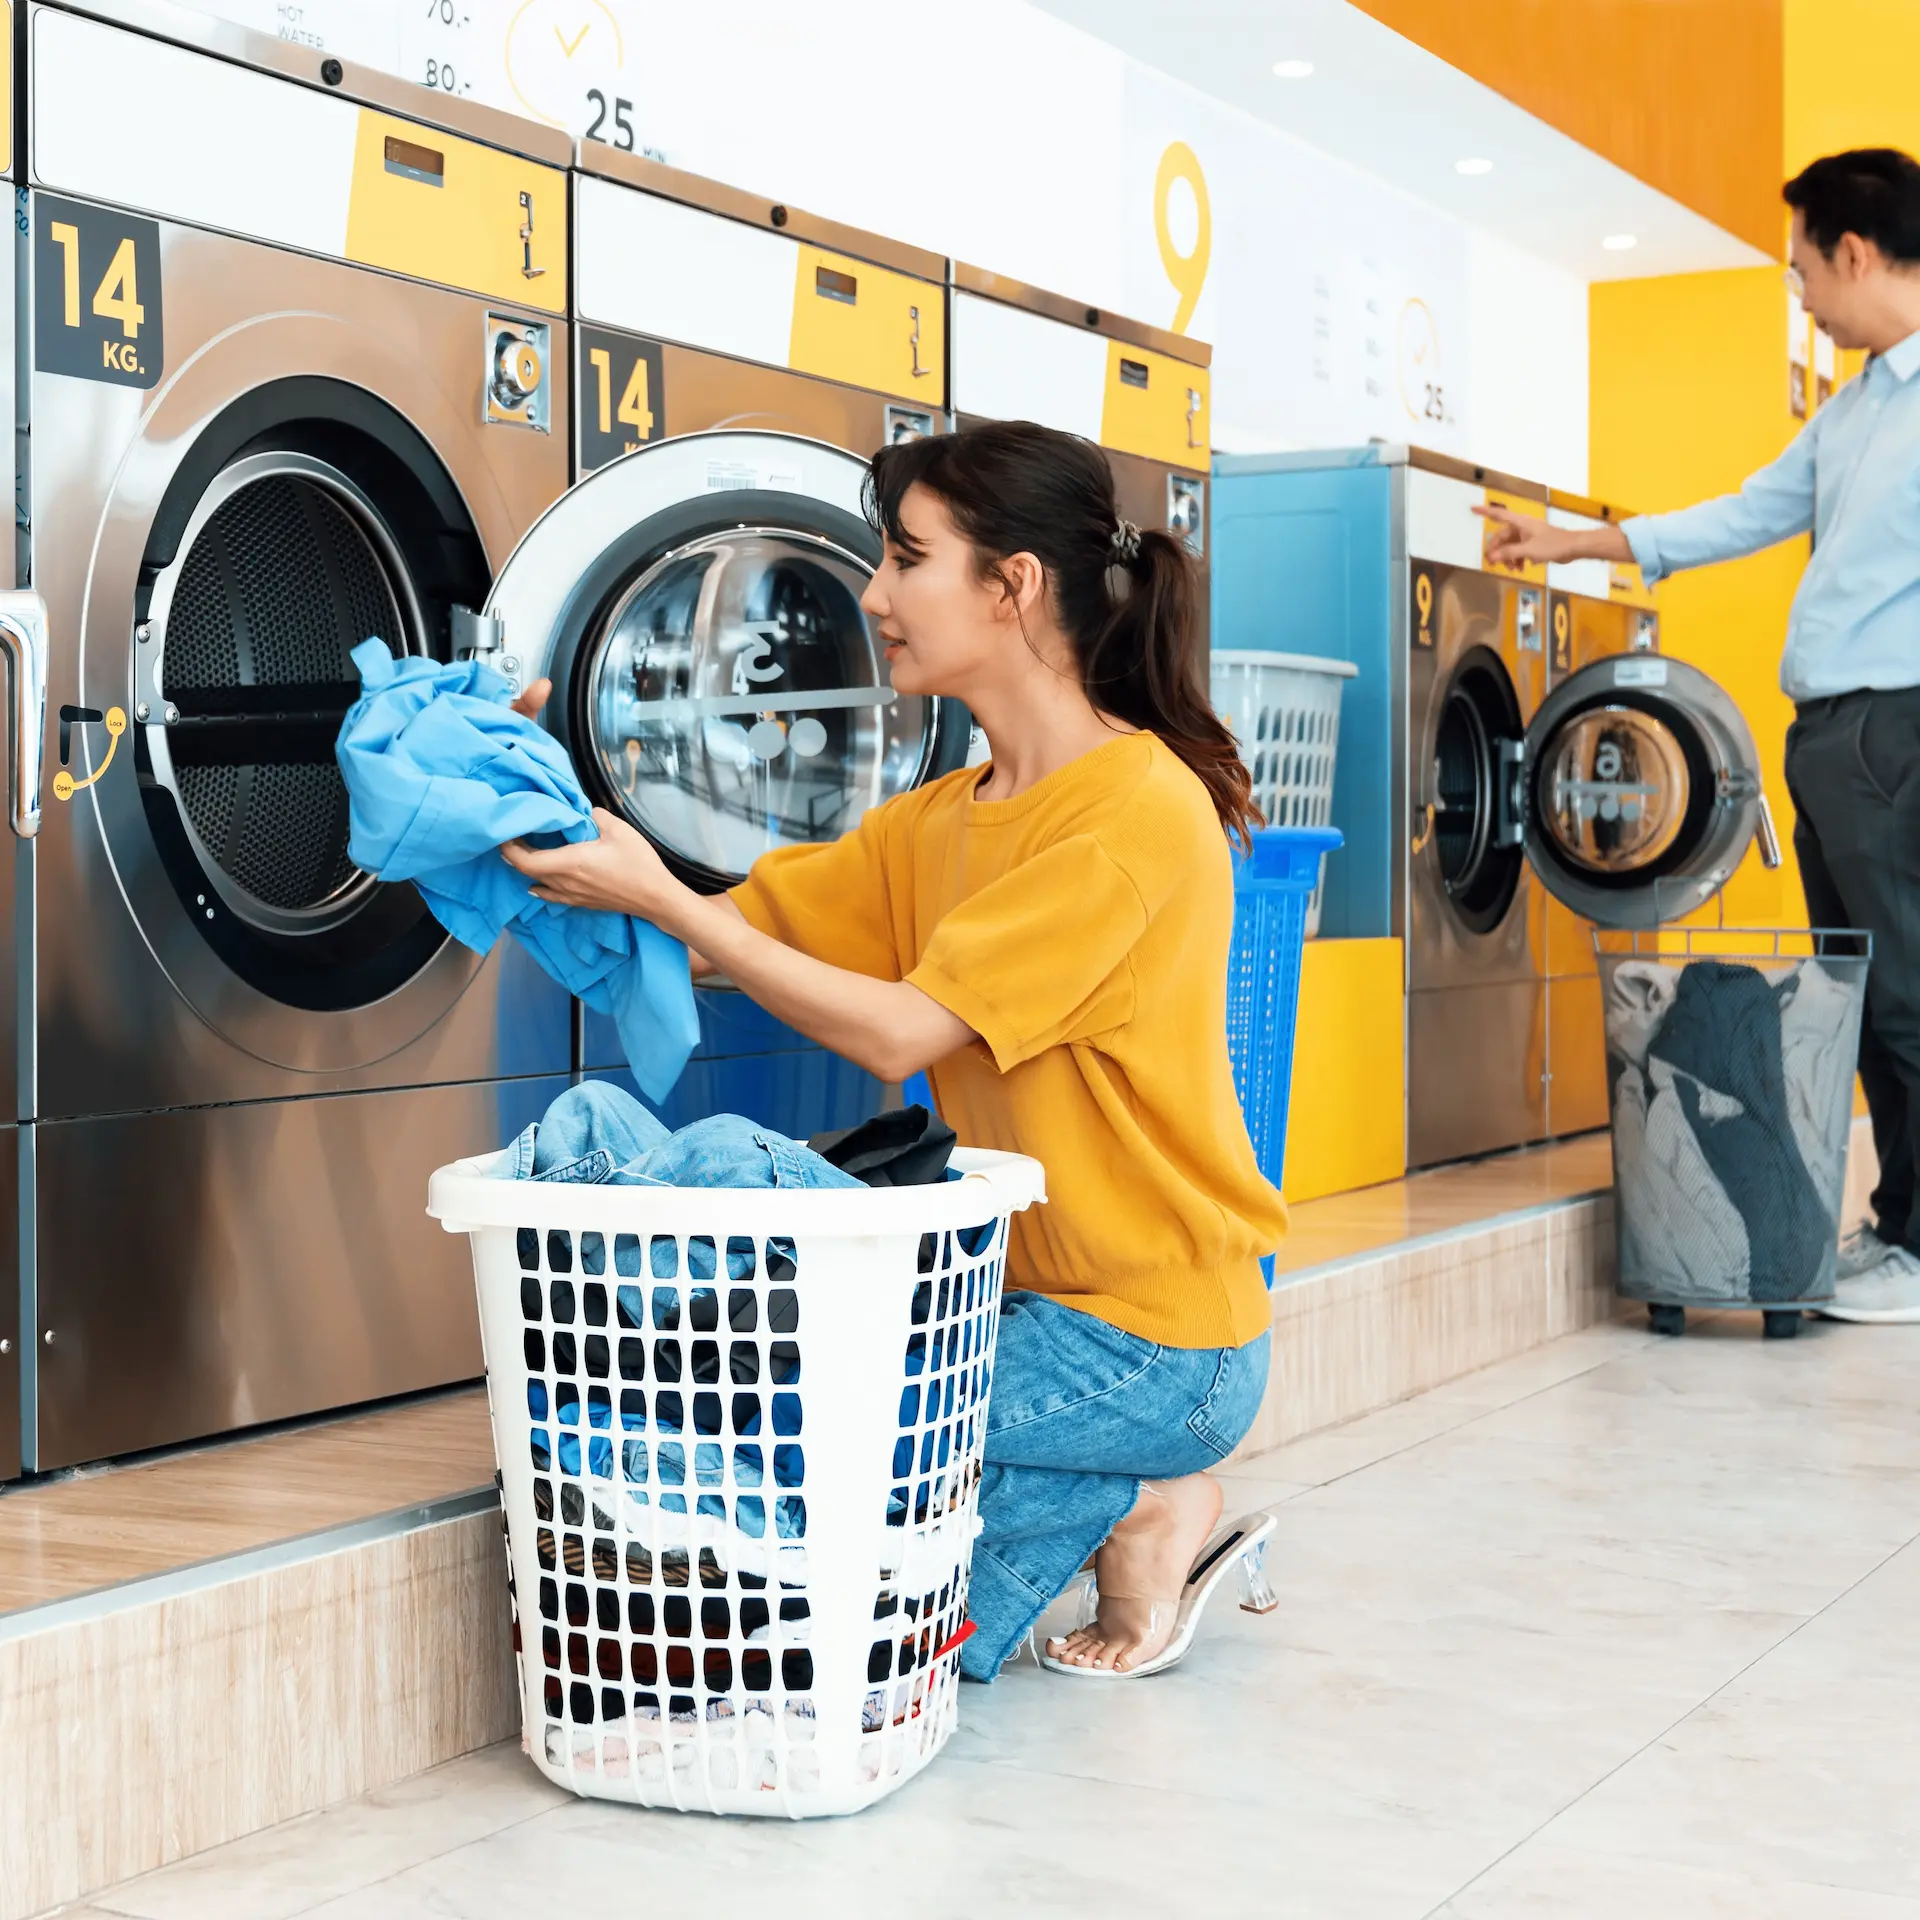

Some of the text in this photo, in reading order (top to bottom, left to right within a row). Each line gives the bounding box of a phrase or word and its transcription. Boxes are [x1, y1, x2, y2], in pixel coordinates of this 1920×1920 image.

[278, 3, 303, 22] HOT
[426, 58, 471, 95] 80.-
[585, 88, 634, 152] 25
[1153, 140, 1212, 336] 9
[51, 220, 145, 339] 14
[103, 340, 145, 375] KG.
[589, 347, 654, 440] 14
[1416, 573, 1432, 628] 9
[1554, 602, 1568, 652] 9
[56, 784, 72, 792] Open
